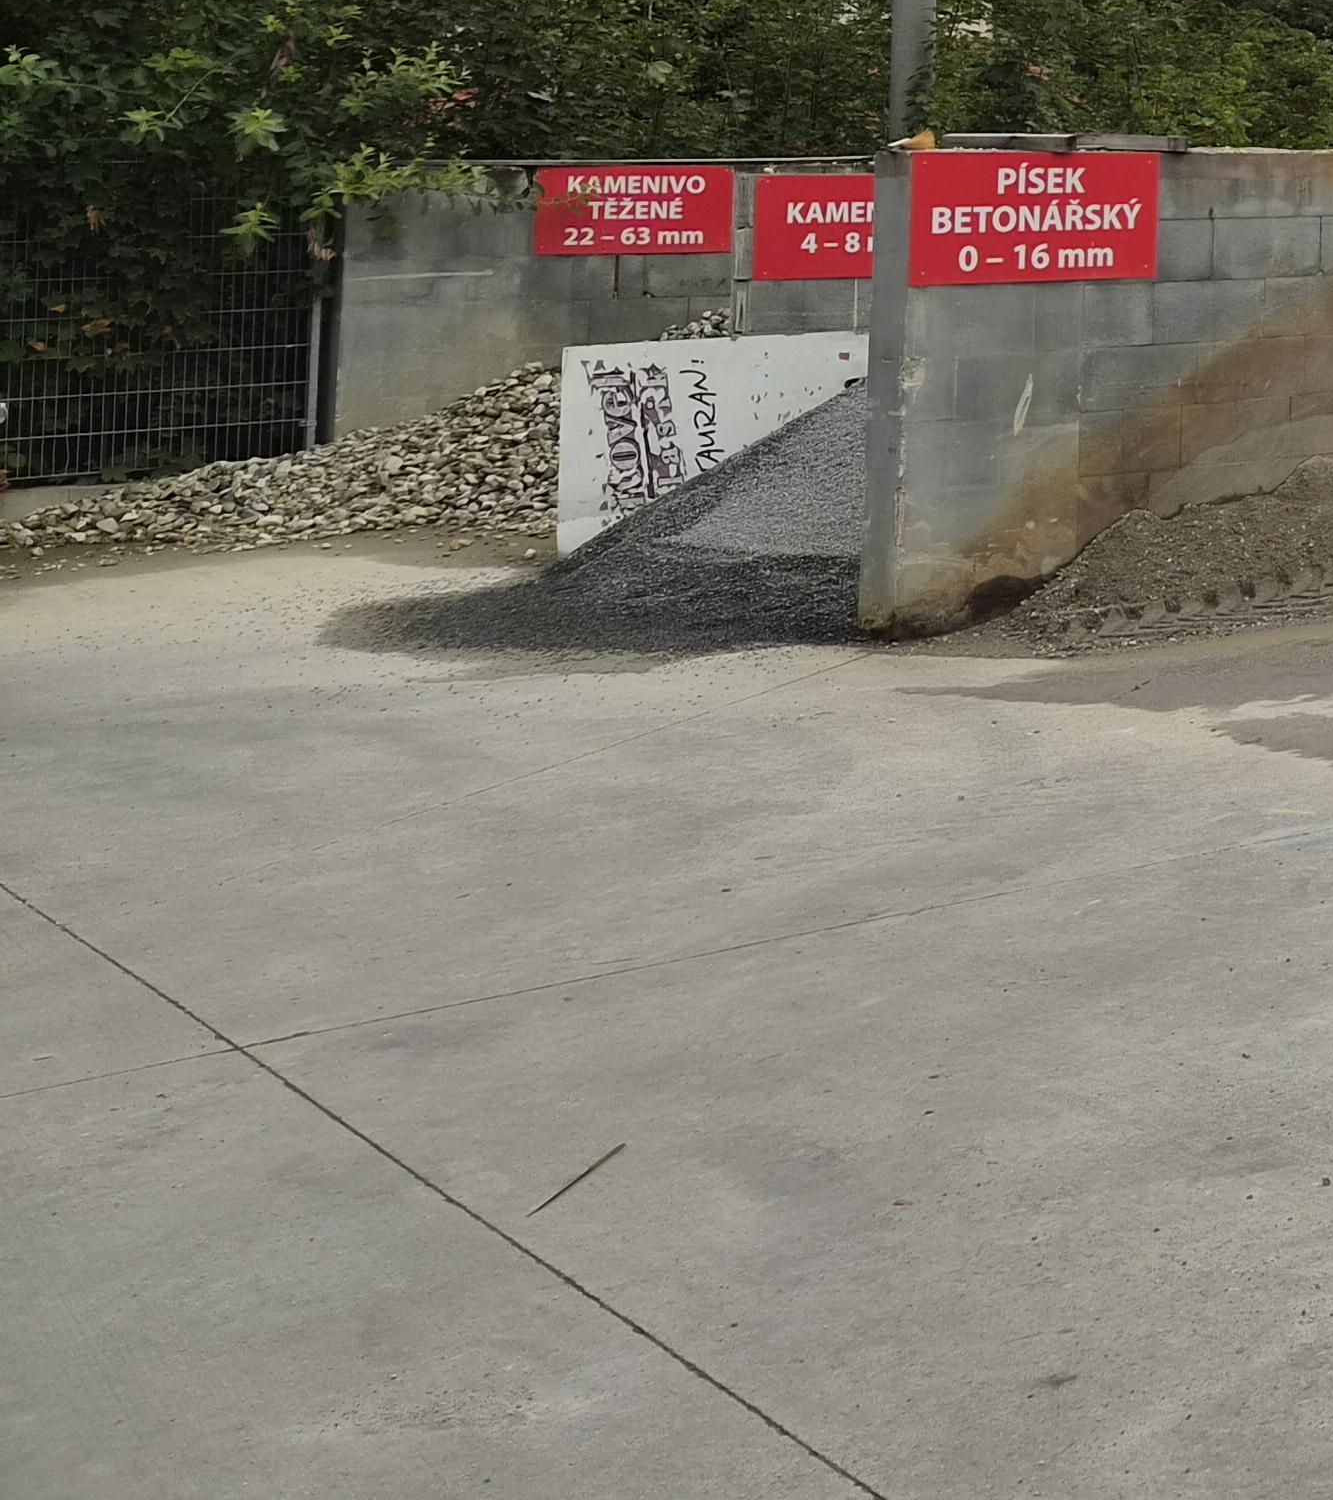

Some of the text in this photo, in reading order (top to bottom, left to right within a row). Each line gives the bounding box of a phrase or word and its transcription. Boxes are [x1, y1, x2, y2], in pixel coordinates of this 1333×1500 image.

[567, 175, 706, 195] KAMENIVO
[997, 162, 1086, 195] PÍSEK
[587, 196, 683, 220] TĚŽENÉ
[931, 197, 1142, 235] BETONÁŘSKÝ
[563, 227, 595, 246] 22
[620, 226, 651, 245] 63
[657, 230, 704, 245] mm
[800, 232, 818, 254] 4
[844, 231, 861, 254] 8
[958, 245, 979, 272] 0
[1013, 243, 1050, 270] 16
[1057, 247, 1114, 269] mm
